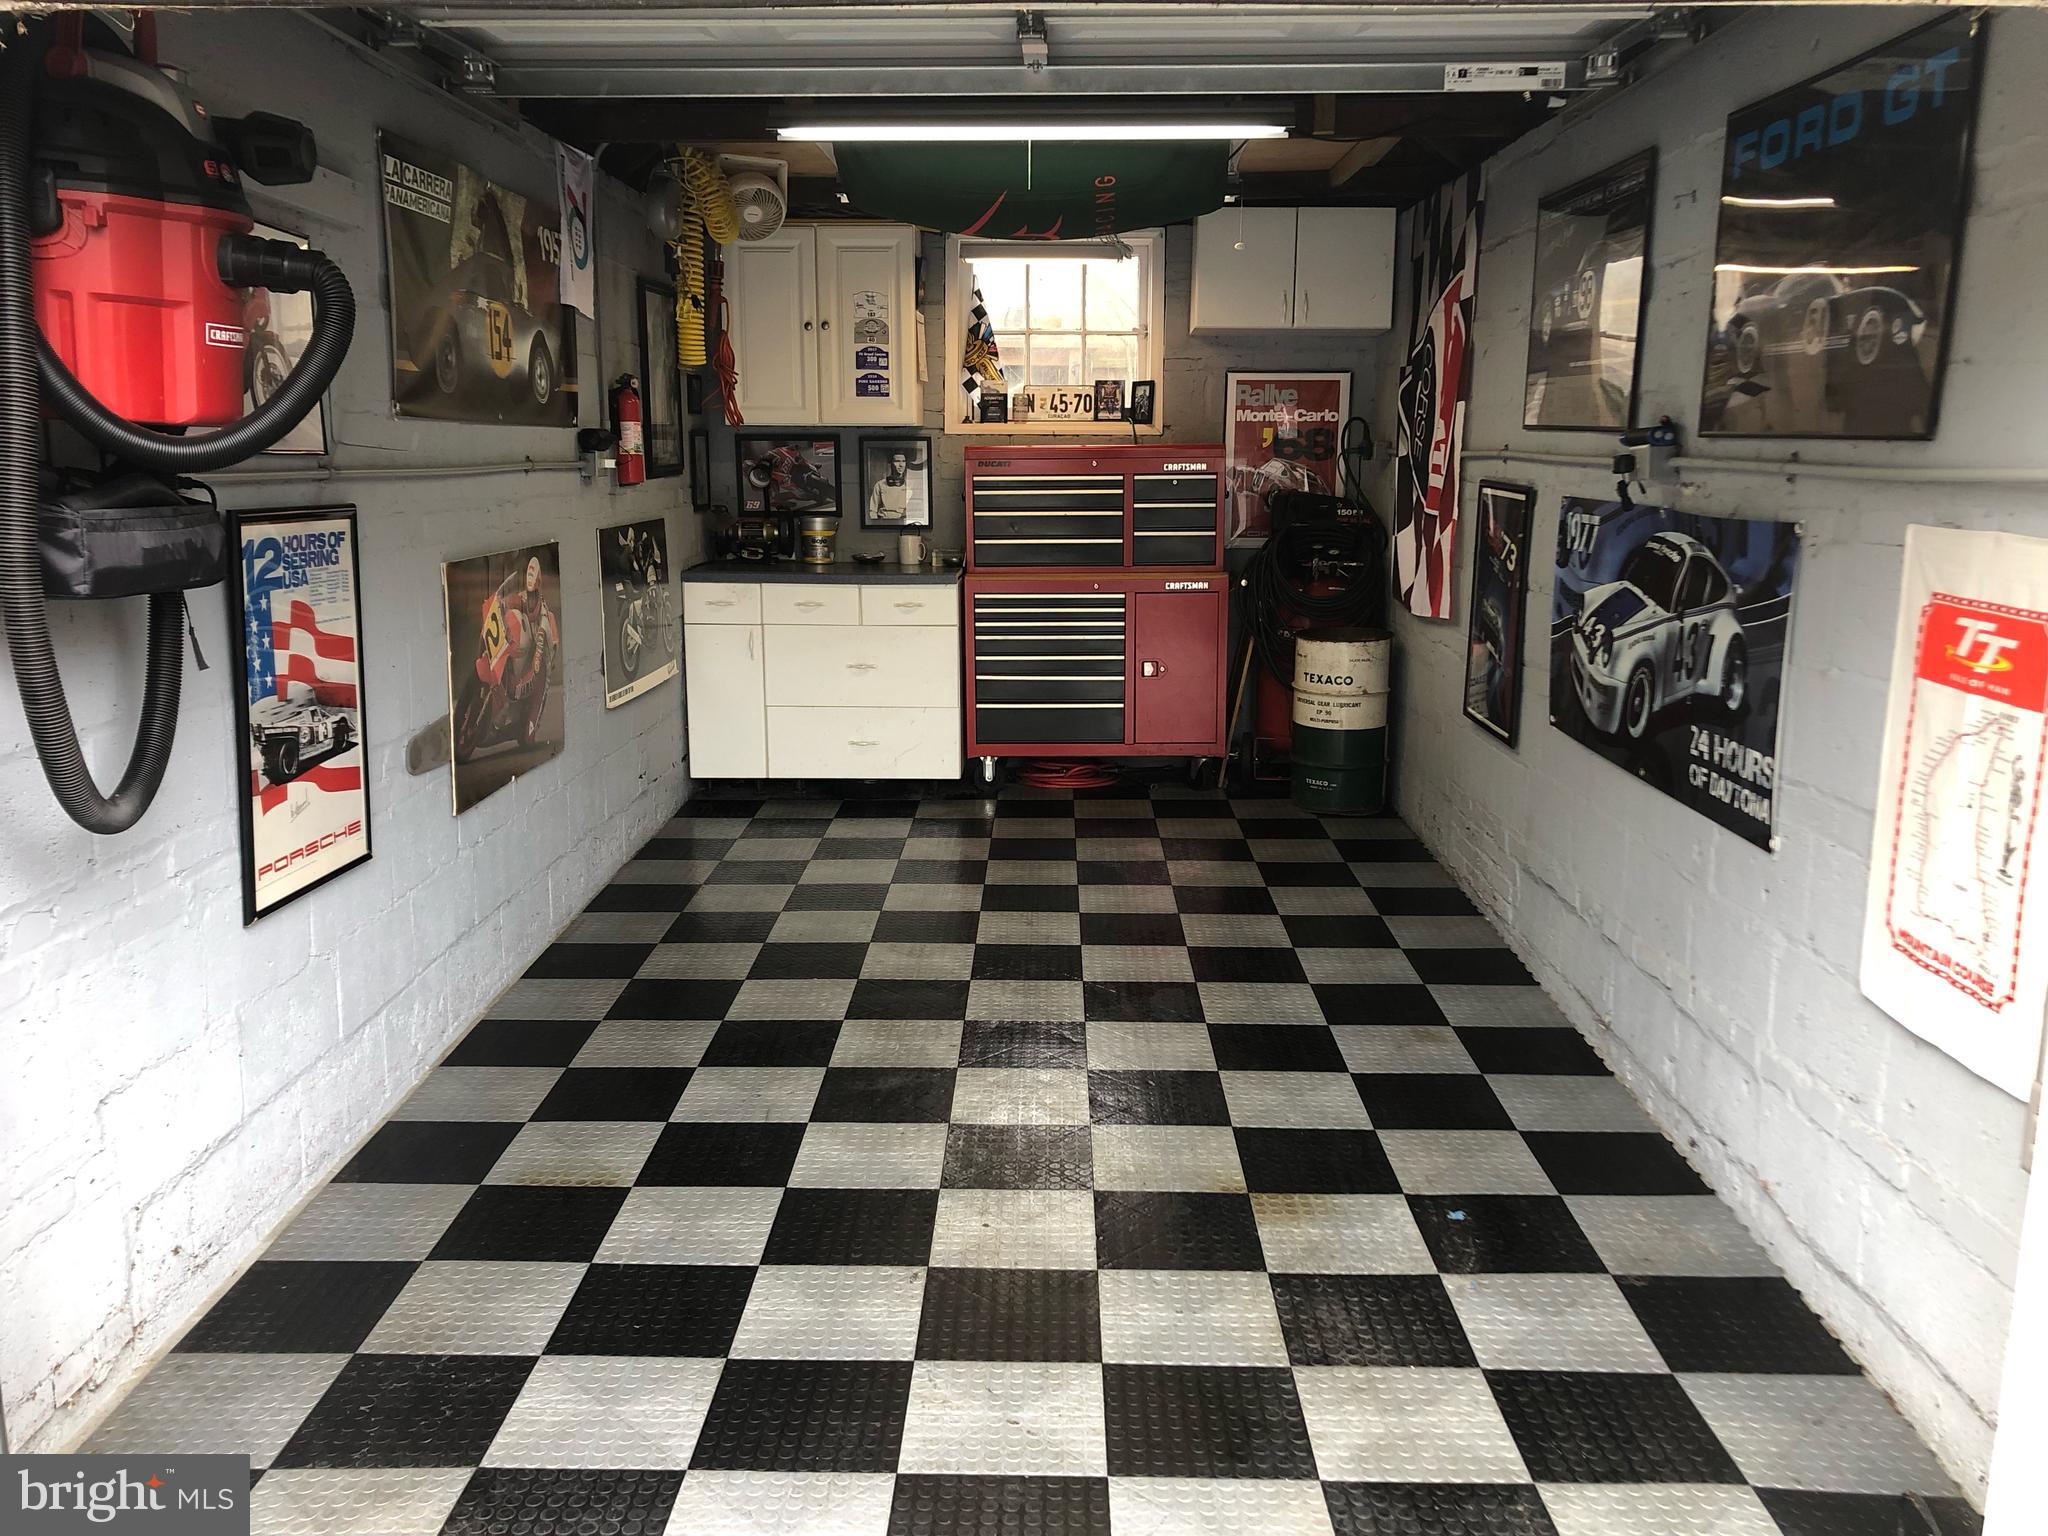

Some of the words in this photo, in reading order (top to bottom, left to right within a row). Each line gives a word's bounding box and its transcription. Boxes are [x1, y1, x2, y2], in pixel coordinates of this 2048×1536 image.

[1733, 91, 1863, 180] FORD
[1883, 47, 1960, 126] GT
[384, 156, 401, 183] LA
[402, 162, 452, 202] CARRERA
[384, 184, 451, 223] PANAMERICANA
[537, 226, 560, 265] 195
[1237, 384, 1298, 411] Rallye
[1413, 343, 1433, 464] CORSE
[1236, 409, 1339, 422] Monte-Carlo
[977, 460, 1012, 468] DUCATI
[1163, 463, 1207, 471] CRAFTSMAN
[744, 500, 760, 509] 69
[1337, 508, 1352, 516] 150
[1567, 511, 1600, 554] 1977
[242, 537, 284, 592] 12
[282, 533, 327, 554] HOURS
[327, 531, 346, 549] OF
[282, 549, 340, 572] SEBRING
[282, 569, 309, 590] USA
[1165, 582, 1209, 590] CRAFTSMAN
[1582, 616, 1606, 648] 43
[1954, 616, 2020, 675] TT
[1303, 672, 1354, 686] TEXACO
[1689, 725, 1709, 760] 24
[1713, 734, 1773, 790] HOURS
[1305, 778, 1328, 787] TEXACO
[1688, 763, 1709, 789] OF
[1709, 771, 1771, 825] DAYTONA
[258, 820, 361, 881] PORSCHE
